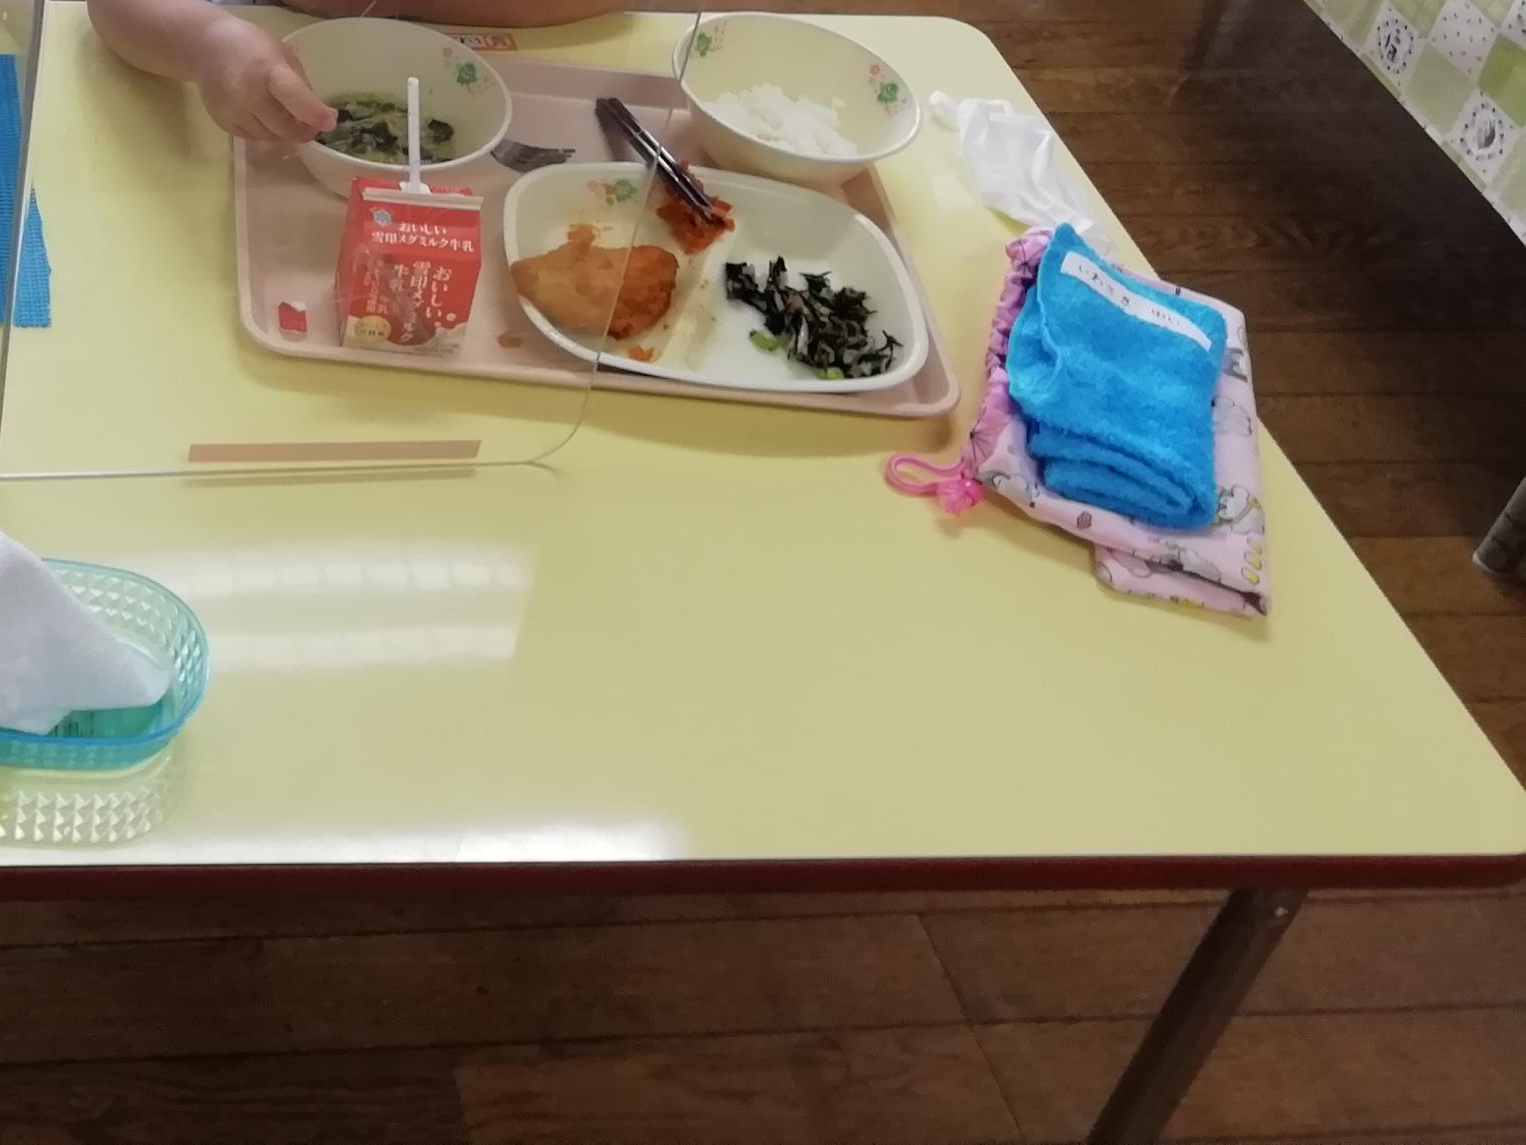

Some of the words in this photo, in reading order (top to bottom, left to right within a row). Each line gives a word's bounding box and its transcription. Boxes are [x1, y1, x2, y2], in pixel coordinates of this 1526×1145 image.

[398, 222, 447, 235] おいしい
[371, 231, 474, 253] 雪印メグミルク牛乳
[425, 266, 452, 319] おいしい
